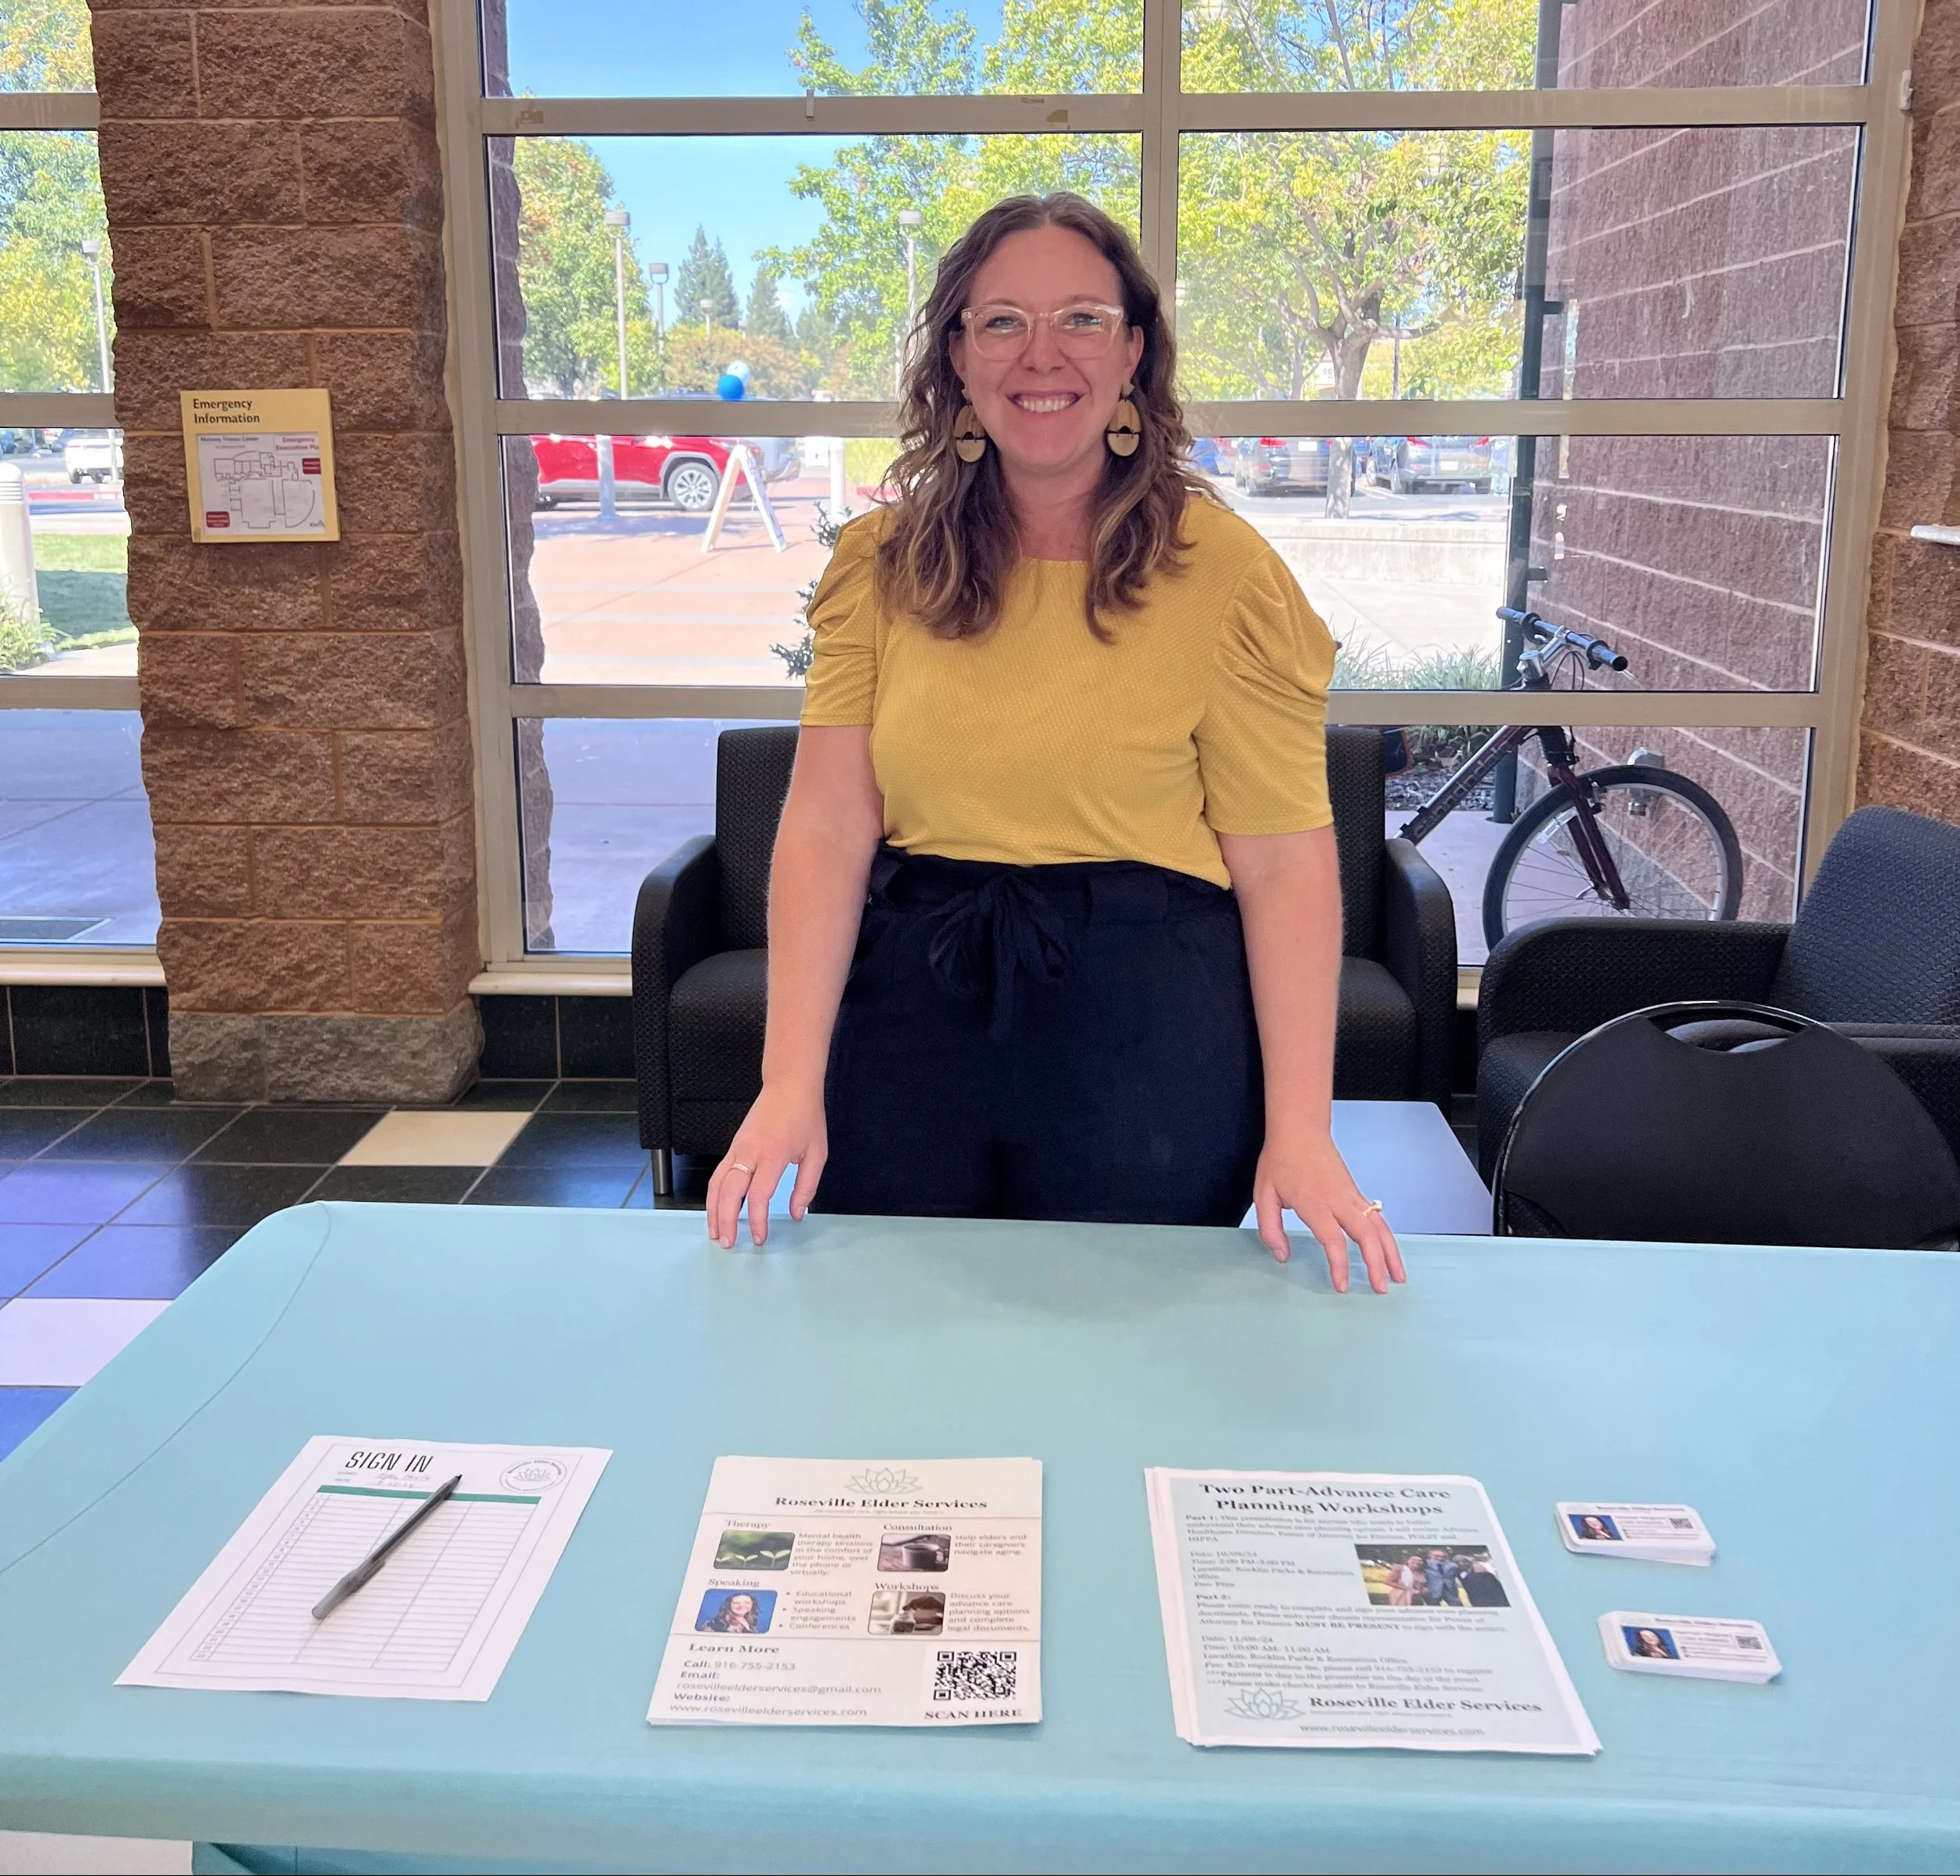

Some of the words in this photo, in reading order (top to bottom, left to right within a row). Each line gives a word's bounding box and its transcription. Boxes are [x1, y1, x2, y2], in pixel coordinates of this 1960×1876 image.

[193, 398, 253, 411] Emergency
[194, 413, 260, 424] Information
[345, 1451, 403, 1471] SIGN
[404, 1454, 434, 1473] IN
[1199, 1483, 1245, 1494] Two
[1251, 1485, 1395, 1498] Part-Advance
[1399, 1488, 1451, 1498] Care
[775, 1497, 856, 1507] Roseville
[861, 1498, 909, 1508] Elder
[913, 1499, 987, 1508] Services
[1216, 1499, 1315, 1514] Planning
[1316, 1501, 1443, 1515] Workshops
[726, 1519, 771, 1529] Therapy
[708, 1578, 760, 1588] Speaking
[875, 1582, 940, 1593] Workshops
[948, 1608, 991, 1617] planning
[947, 1624, 971, 1632] legal
[688, 1643, 735, 1653] Learn
[739, 1644, 781, 1653] More
[684, 1660, 711, 1669] Call:
[680, 1671, 720, 1679] Email:
[677, 1682, 883, 1695] rosevilleelderservices@gmail.com
[673, 1693, 731, 1702] Website:
[1308, 1696, 1398, 1707] Roseville
[1402, 1697, 1457, 1710] Elder
[1459, 1700, 1544, 1712] Services
[670, 1704, 868, 1716] www.rosevilleelderservices.com
[924, 1711, 970, 1719] SCAN
[975, 1709, 1022, 1718] HERE
